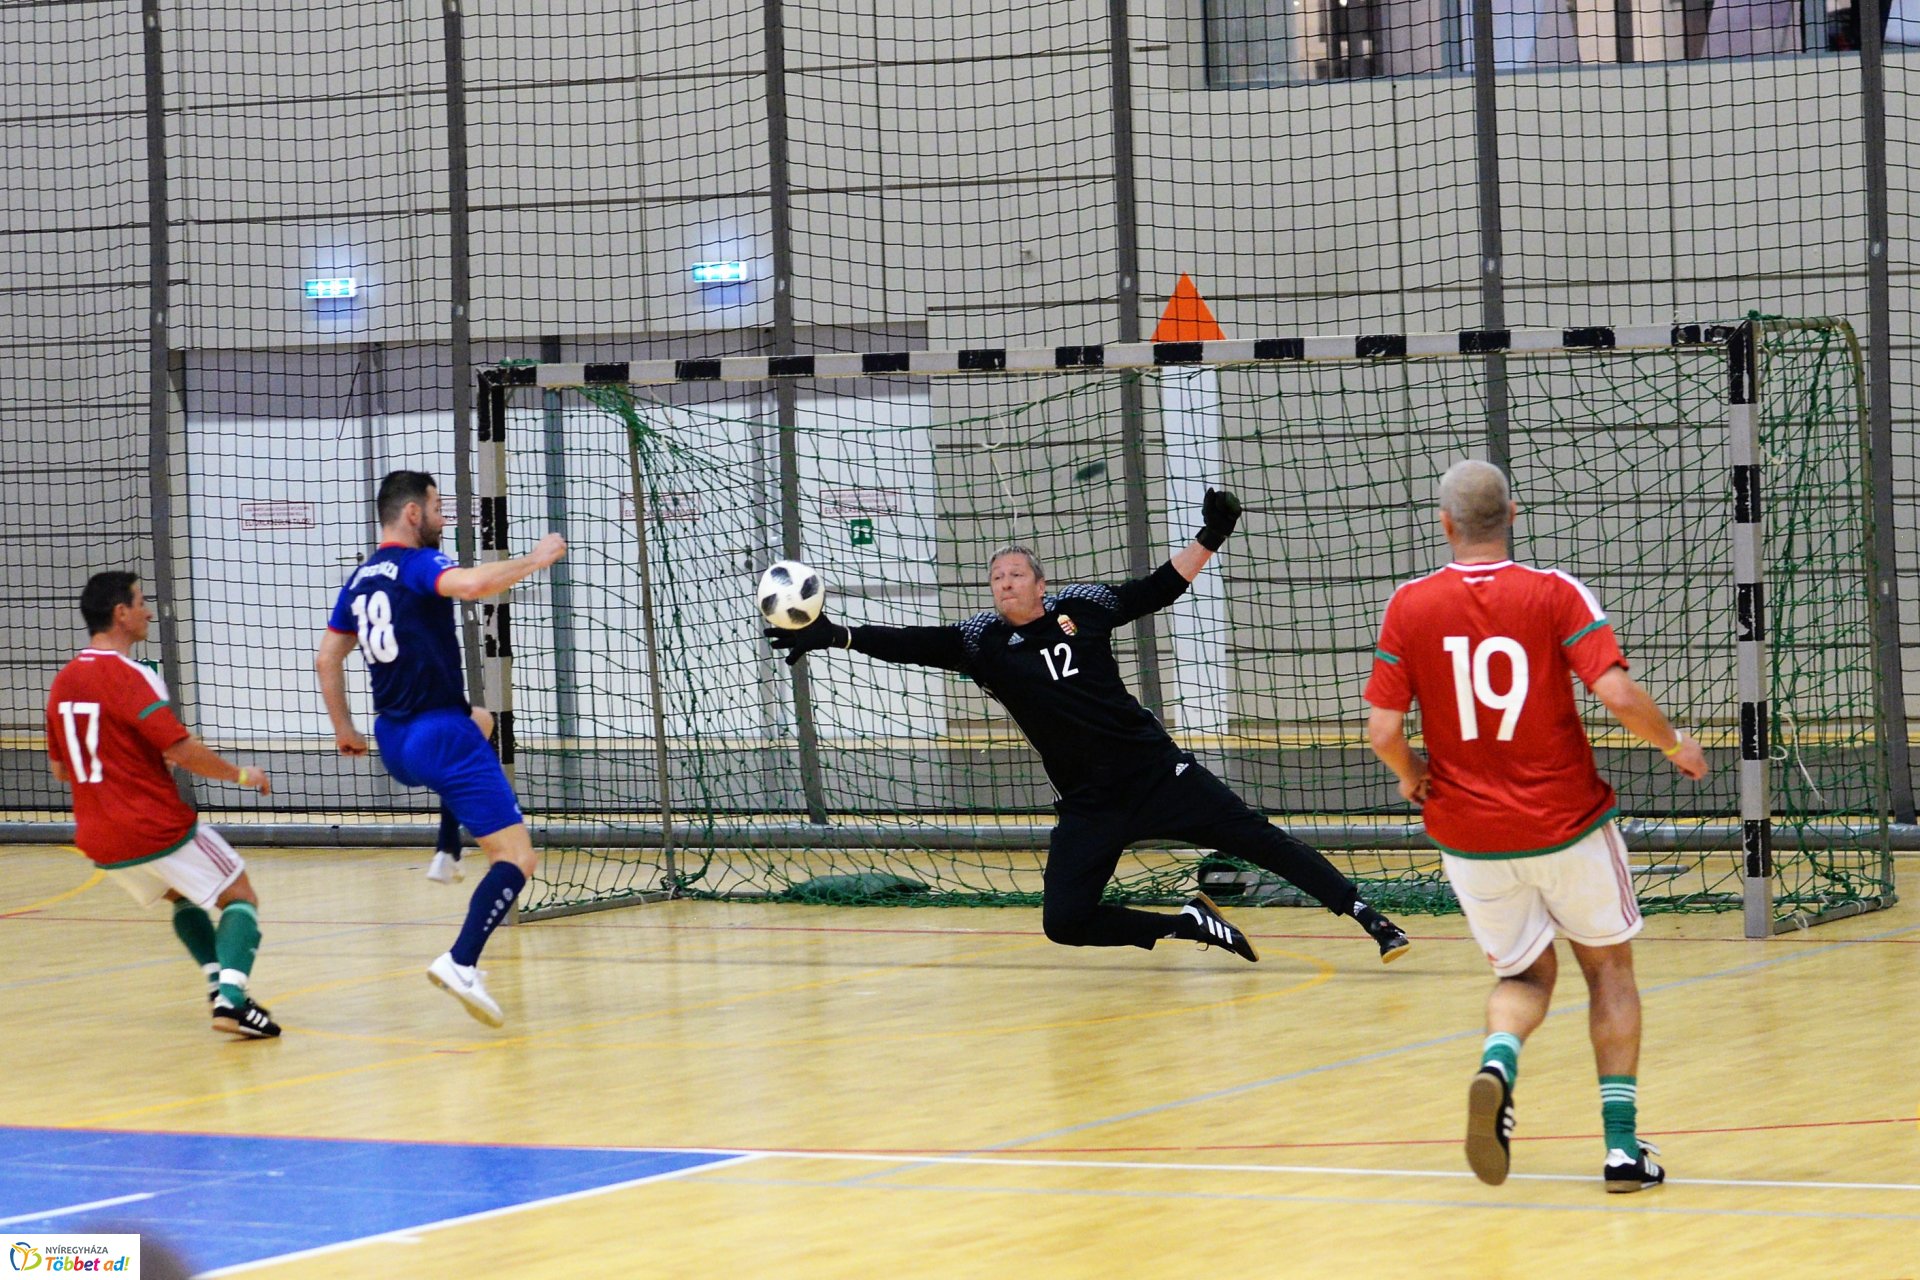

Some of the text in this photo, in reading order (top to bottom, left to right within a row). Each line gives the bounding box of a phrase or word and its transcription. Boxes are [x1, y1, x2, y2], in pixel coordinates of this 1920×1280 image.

[350, 590, 399, 664] 18
[1040, 642, 1079, 681] 12
[1443, 636, 1529, 741] 19
[58, 701, 103, 783] 17
